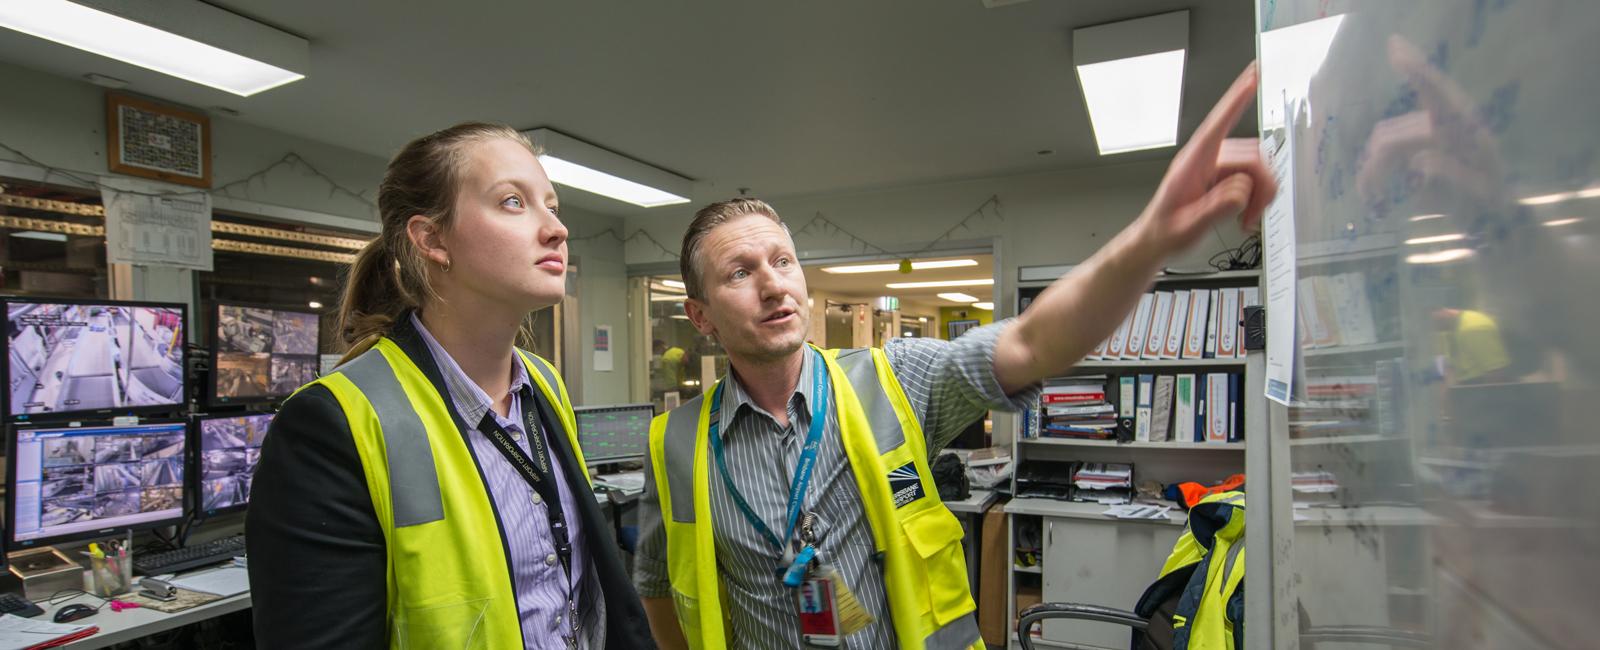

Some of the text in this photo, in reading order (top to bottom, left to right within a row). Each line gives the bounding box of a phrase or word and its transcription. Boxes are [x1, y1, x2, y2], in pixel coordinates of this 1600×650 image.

[493, 430, 525, 465] CORPORATION
[528, 411, 549, 473] AIRPORT CORPORATION
